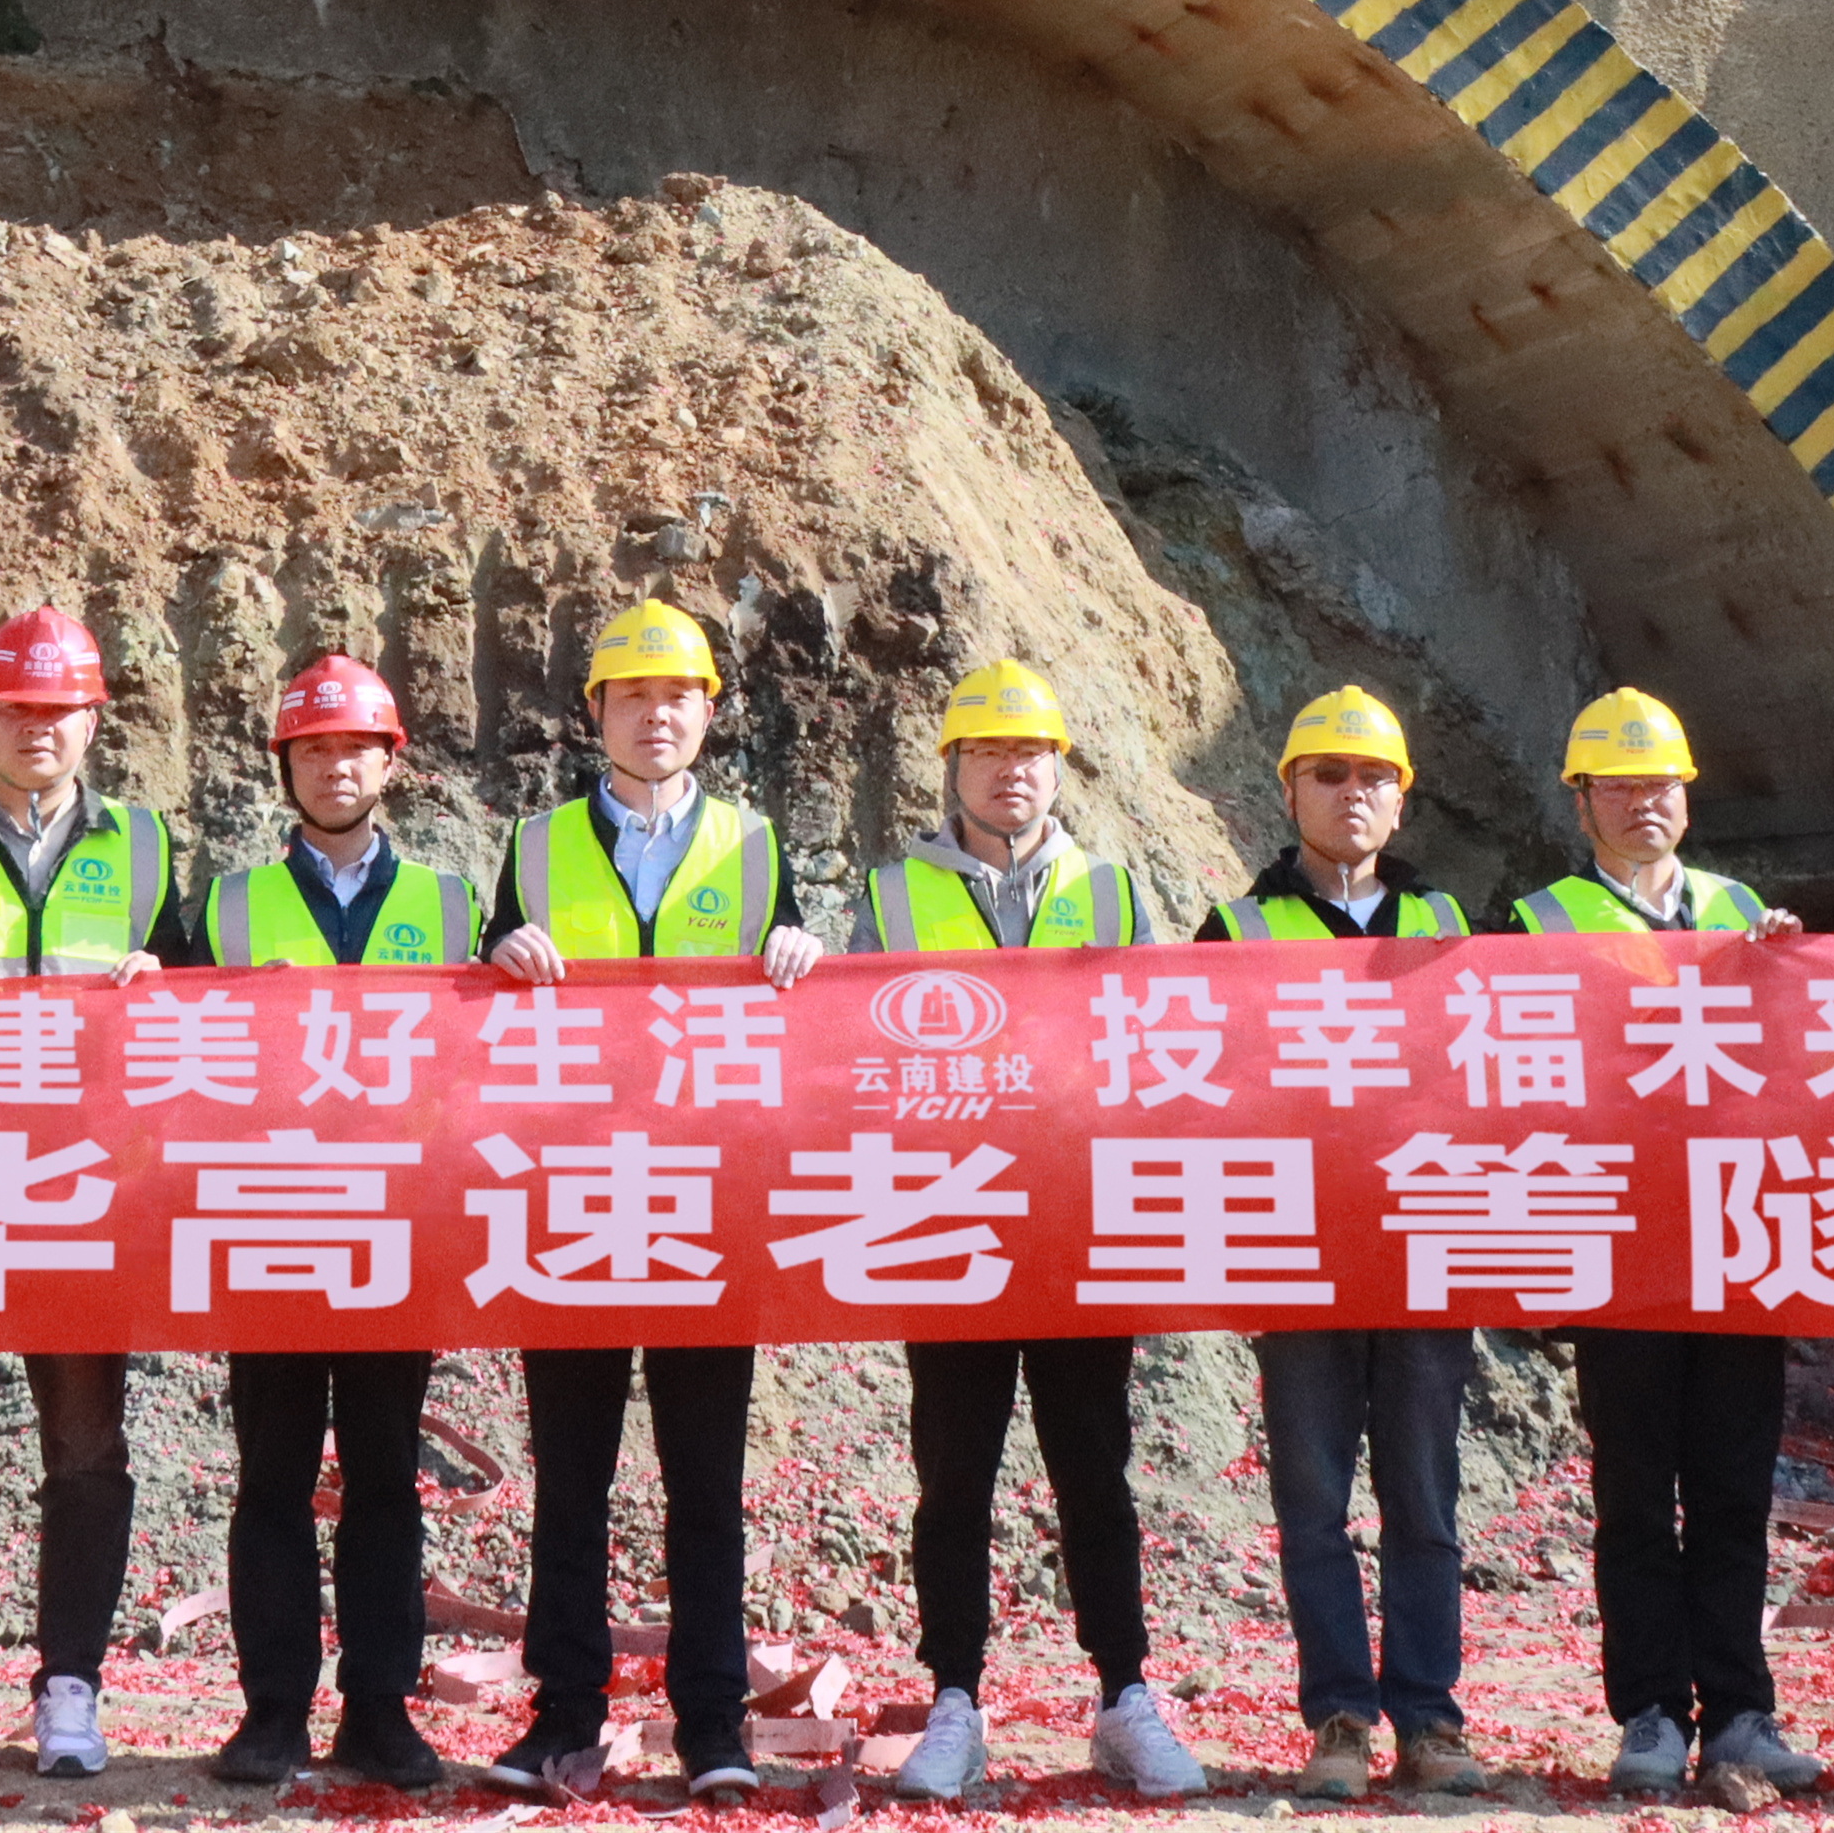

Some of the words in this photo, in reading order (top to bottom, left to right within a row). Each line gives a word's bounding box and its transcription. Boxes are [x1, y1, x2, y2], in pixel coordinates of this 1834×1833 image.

[687, 916, 728, 930] YCIH
[851, 1053, 1034, 1093] 云南建投
[895, 1096, 994, 1120] YCIH
